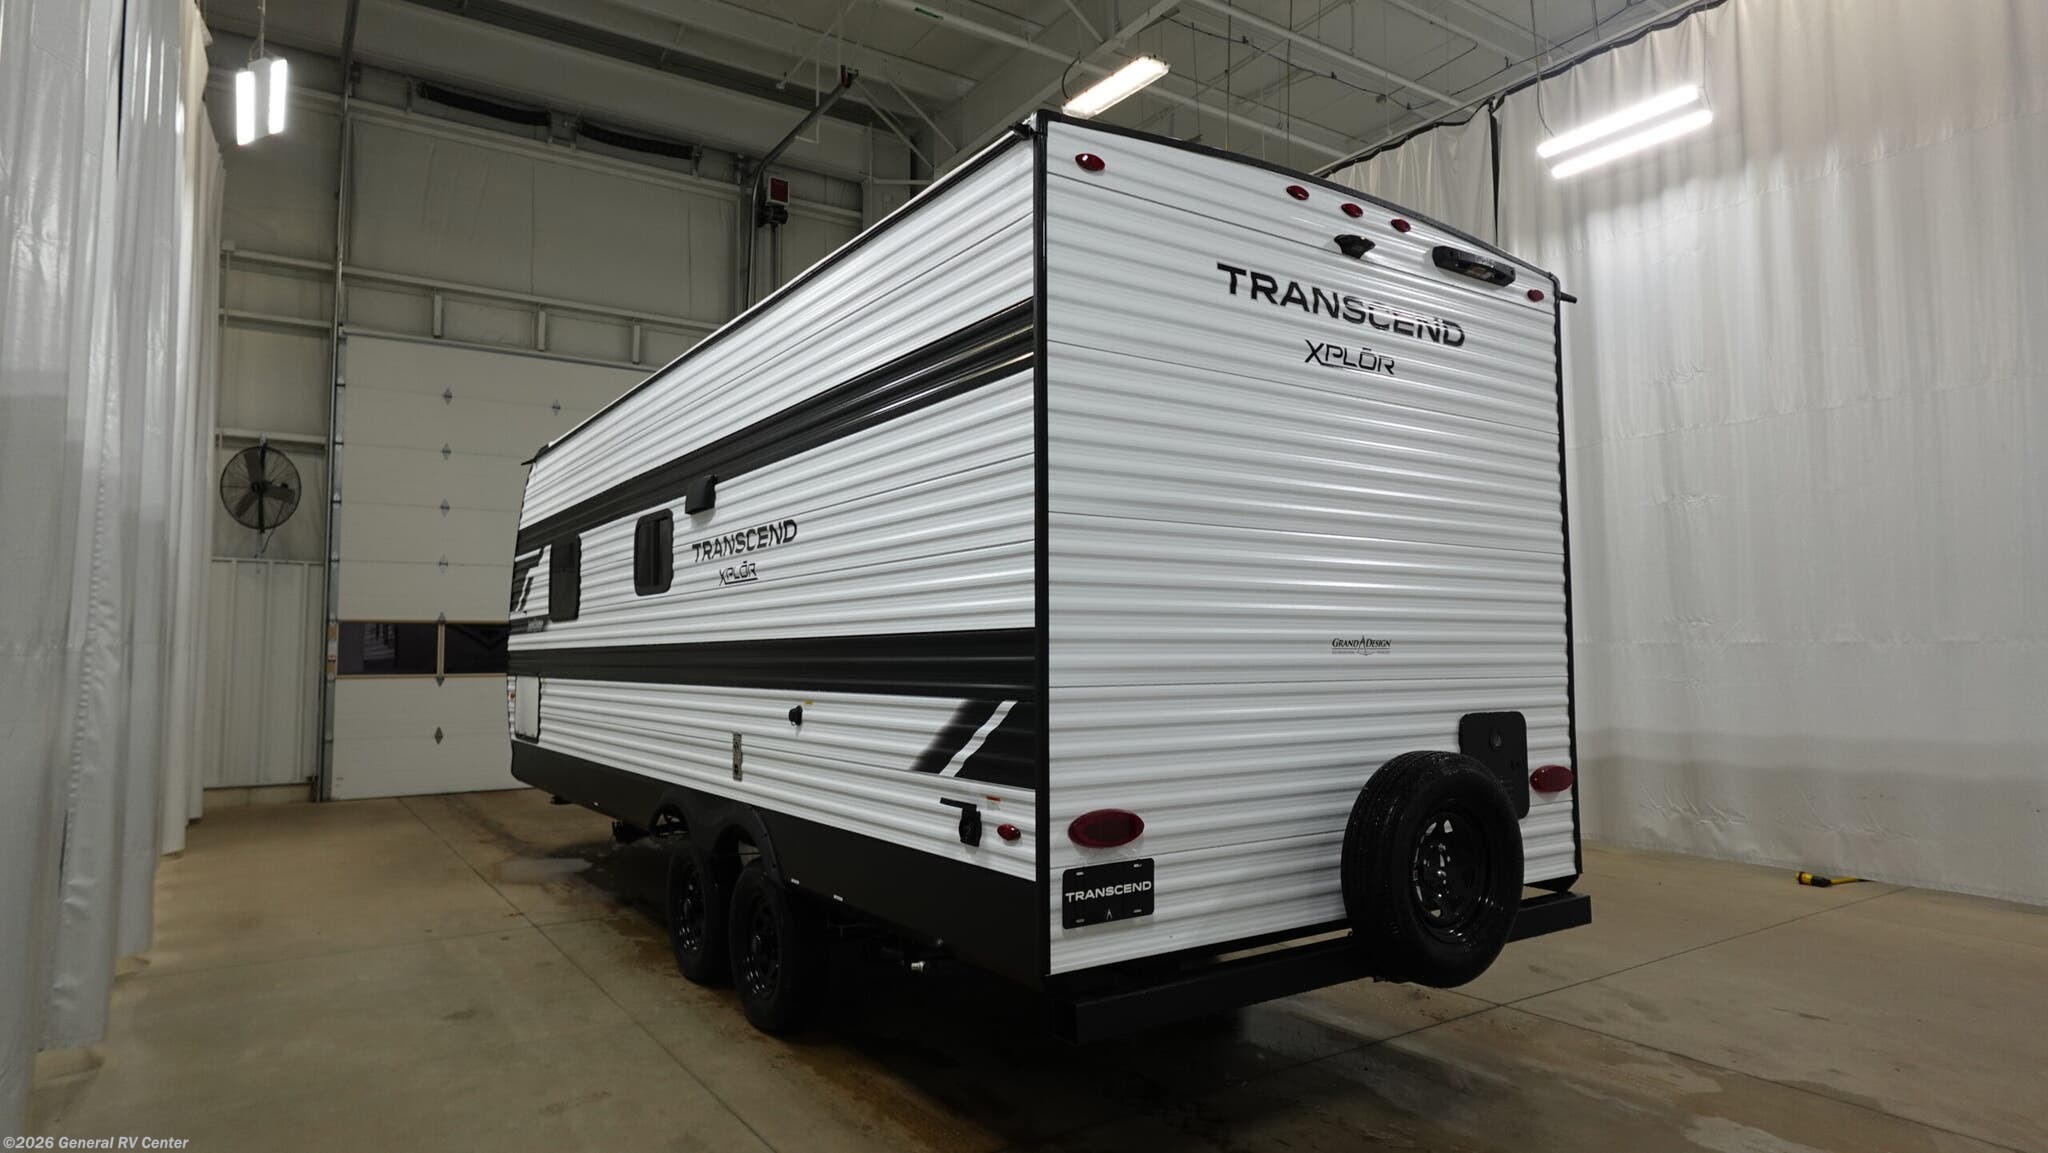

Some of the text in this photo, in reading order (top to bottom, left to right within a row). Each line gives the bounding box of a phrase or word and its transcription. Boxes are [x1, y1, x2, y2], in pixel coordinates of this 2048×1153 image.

[1217, 262, 1465, 347] TRANSCEND
[692, 519, 798, 562] TRANSCEND
[1065, 881, 1152, 903] TRANSCEND
